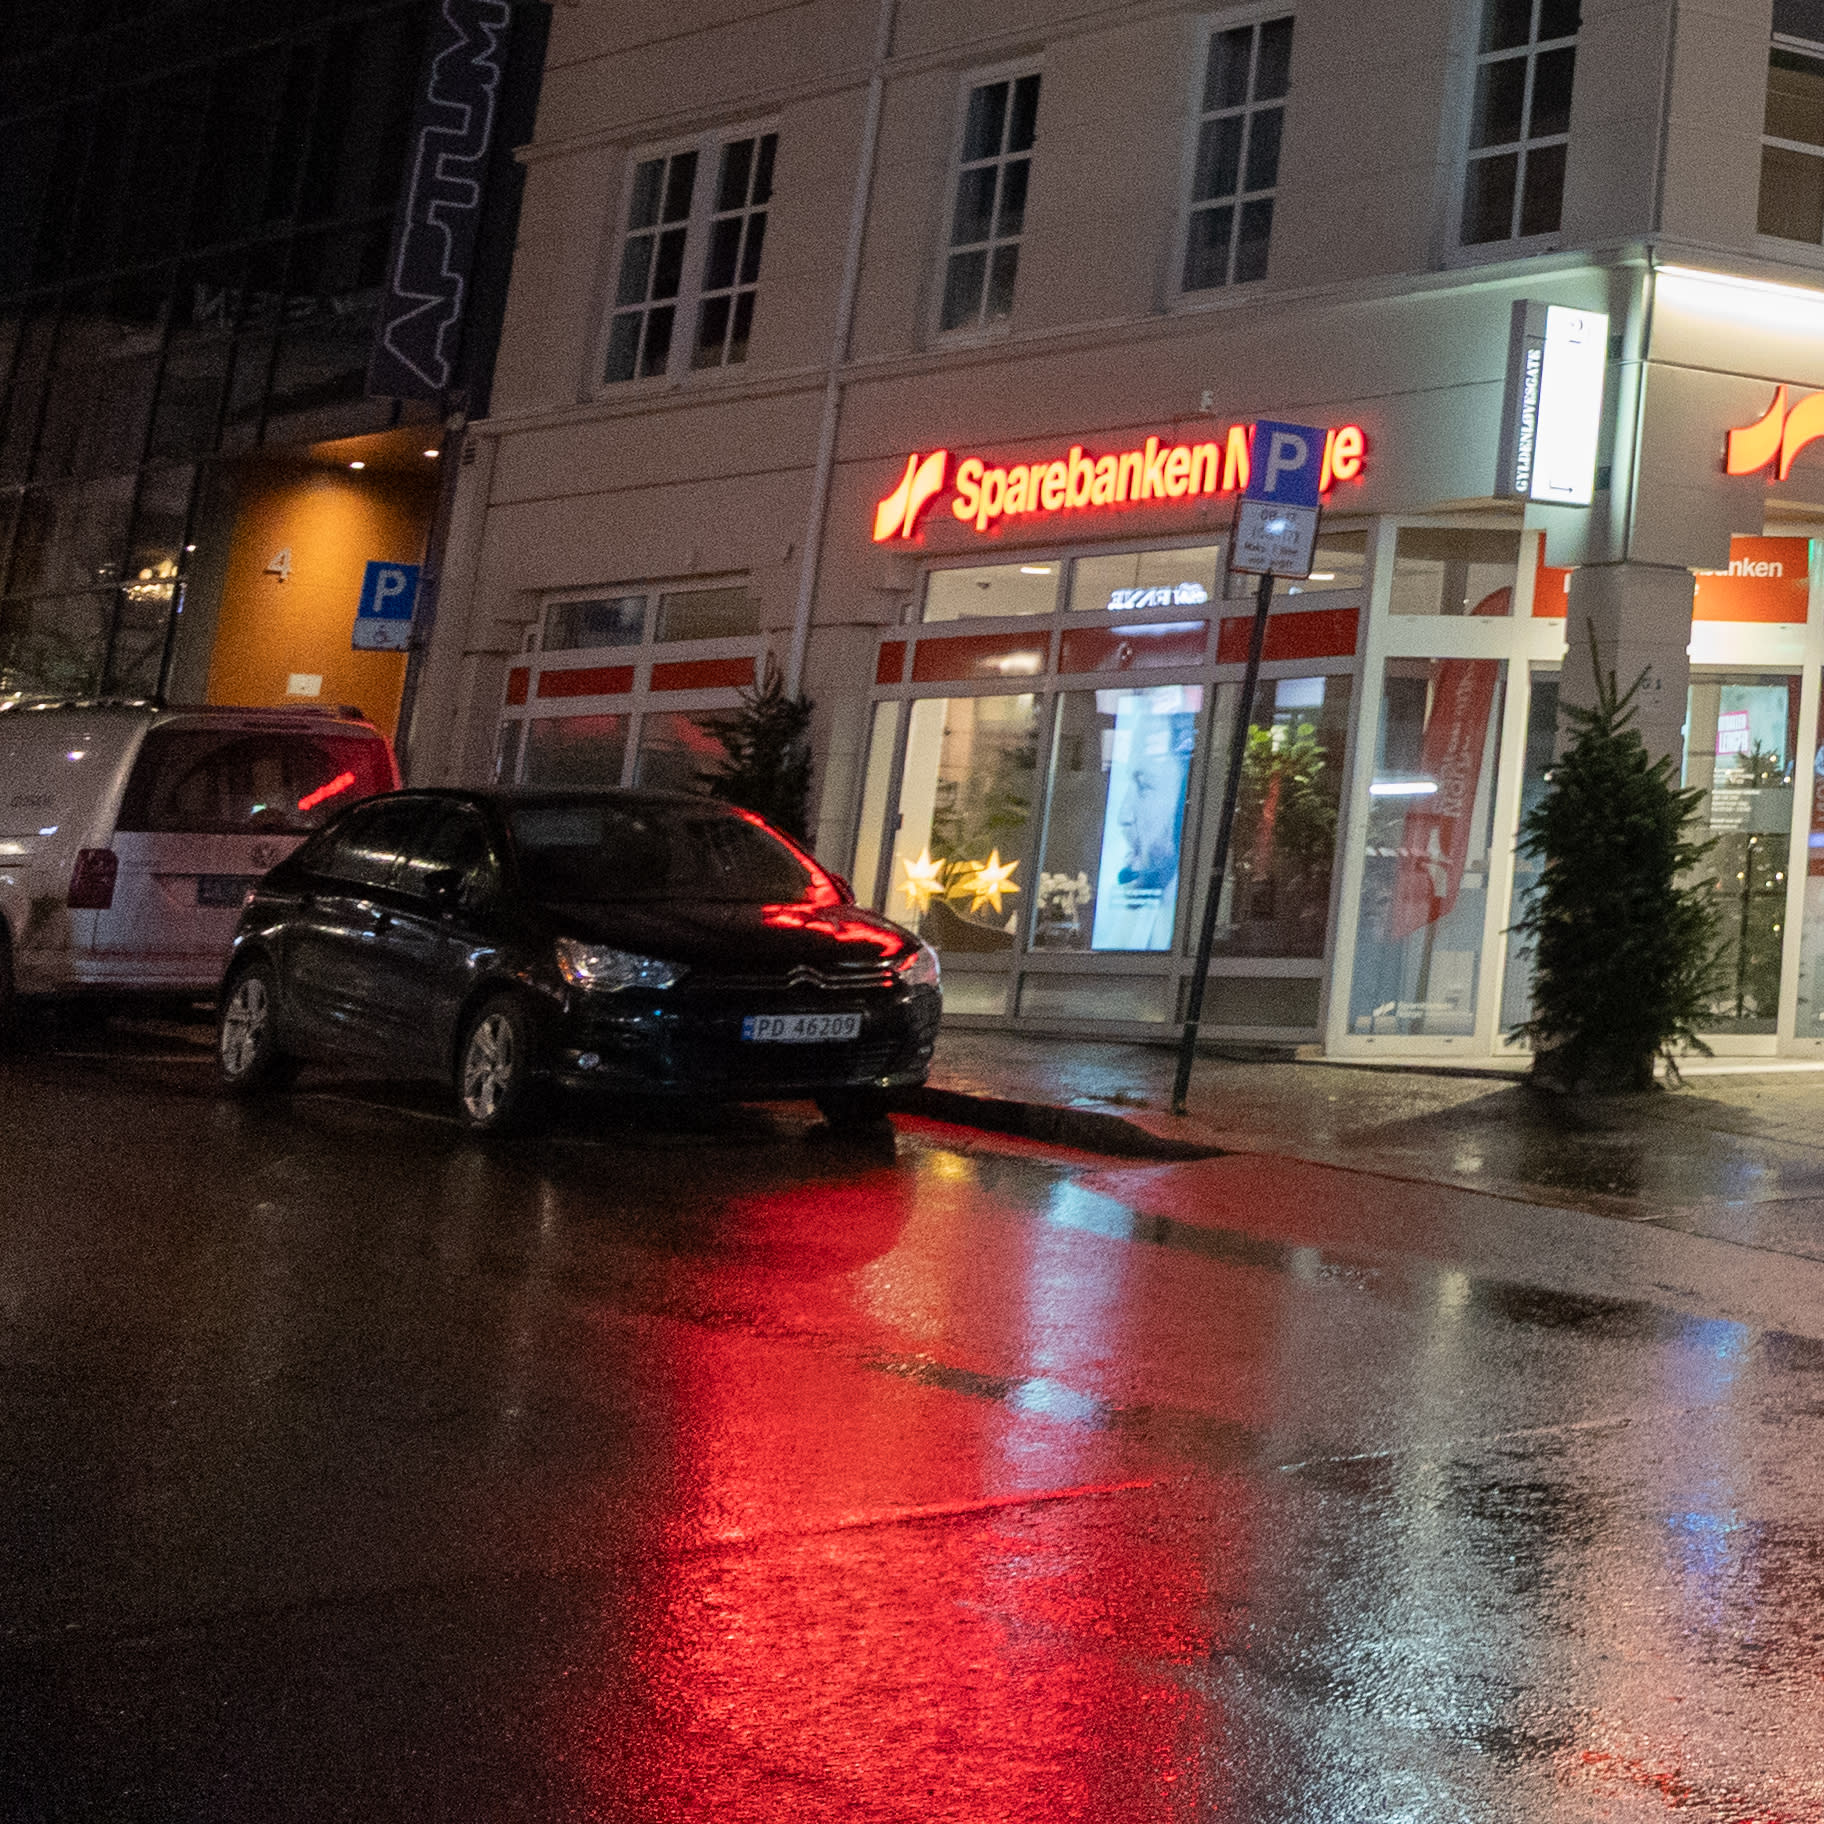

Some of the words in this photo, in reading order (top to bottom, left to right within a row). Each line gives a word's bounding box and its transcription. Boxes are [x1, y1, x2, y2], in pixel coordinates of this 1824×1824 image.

[1514, 348, 1543, 494] GYLDENLØVESGATE
[951, 435, 1220, 532] Sparebanken
[1263, 431, 1309, 493] P
[263, 547, 294, 584] 4
[371, 569, 407, 613] P
[757, 1018, 786, 1038] PD
[793, 1016, 857, 1037] 46209
